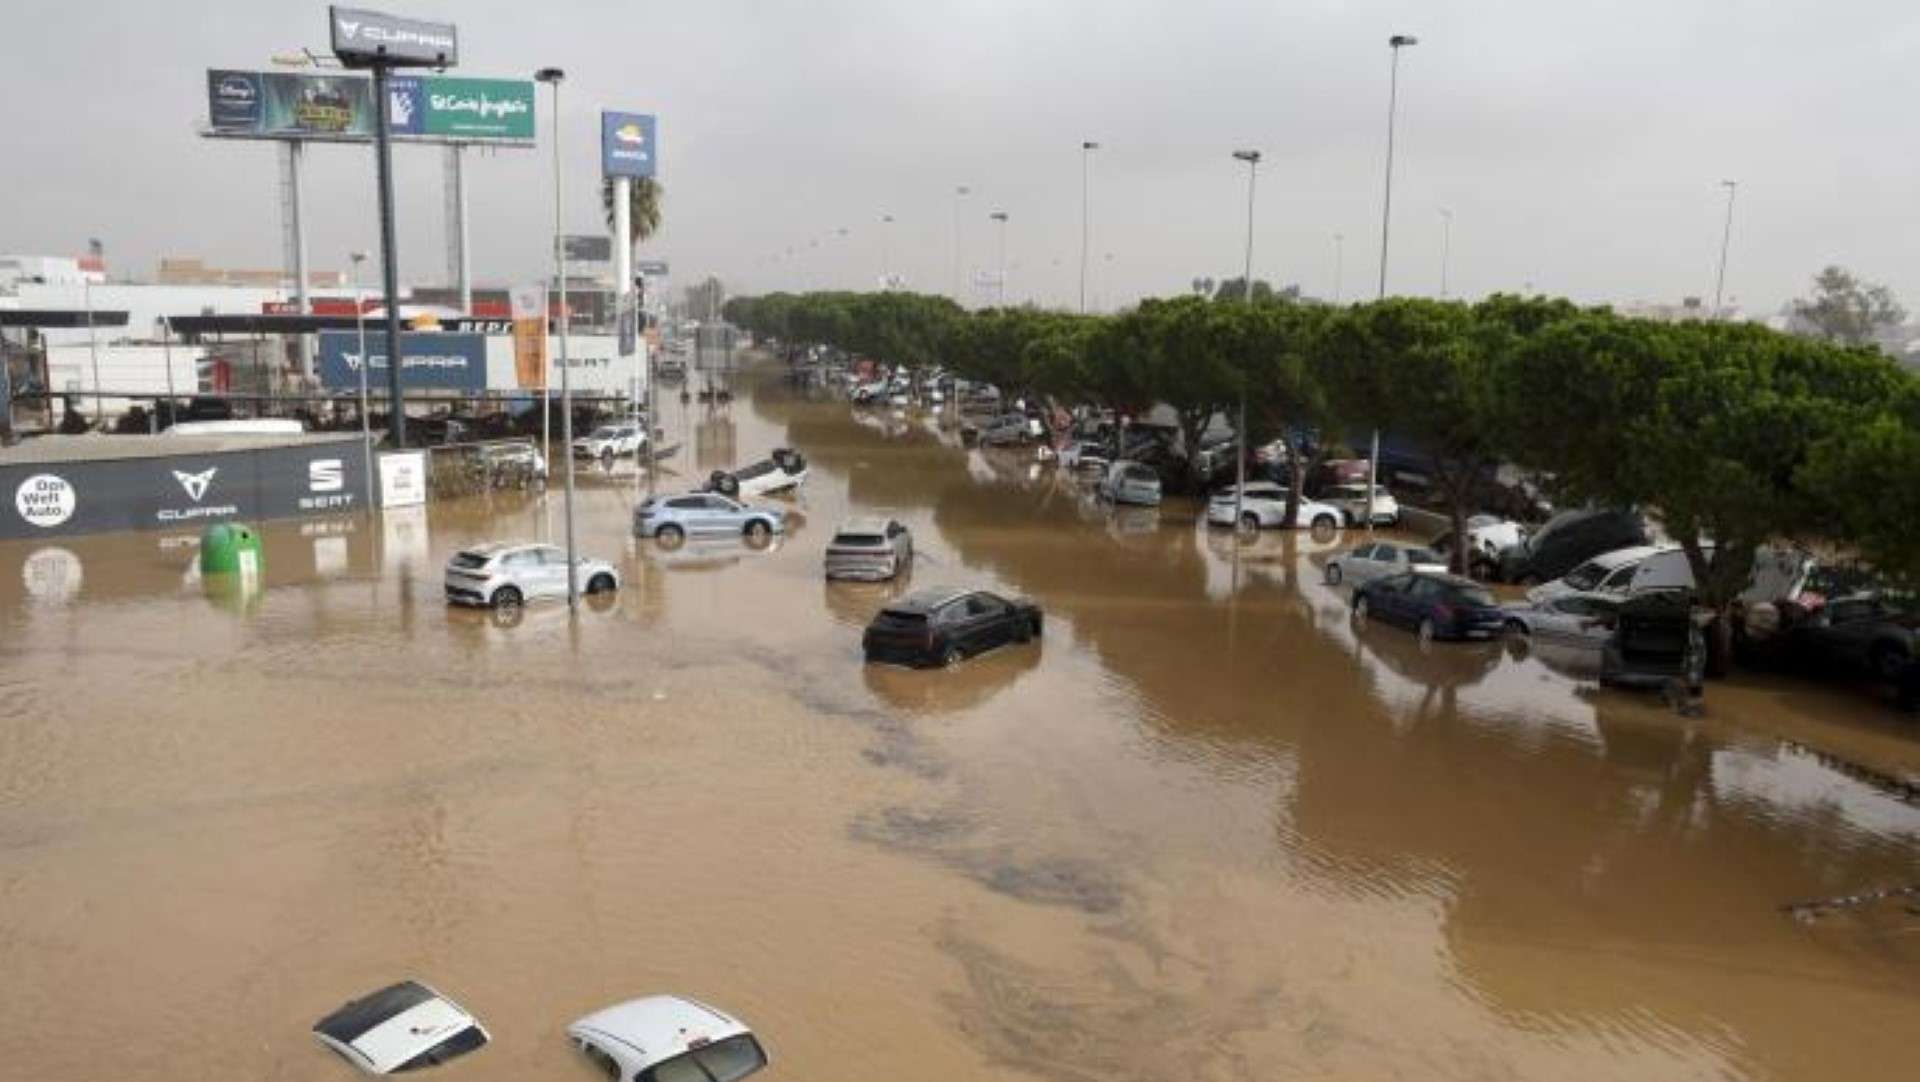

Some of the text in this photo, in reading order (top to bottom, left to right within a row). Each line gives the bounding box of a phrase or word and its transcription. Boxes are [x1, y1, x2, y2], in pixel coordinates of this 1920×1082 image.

[361, 26, 454, 45] CUPRA
[299, 495, 354, 508] SEAT
[157, 504, 238, 520] CUPRA
